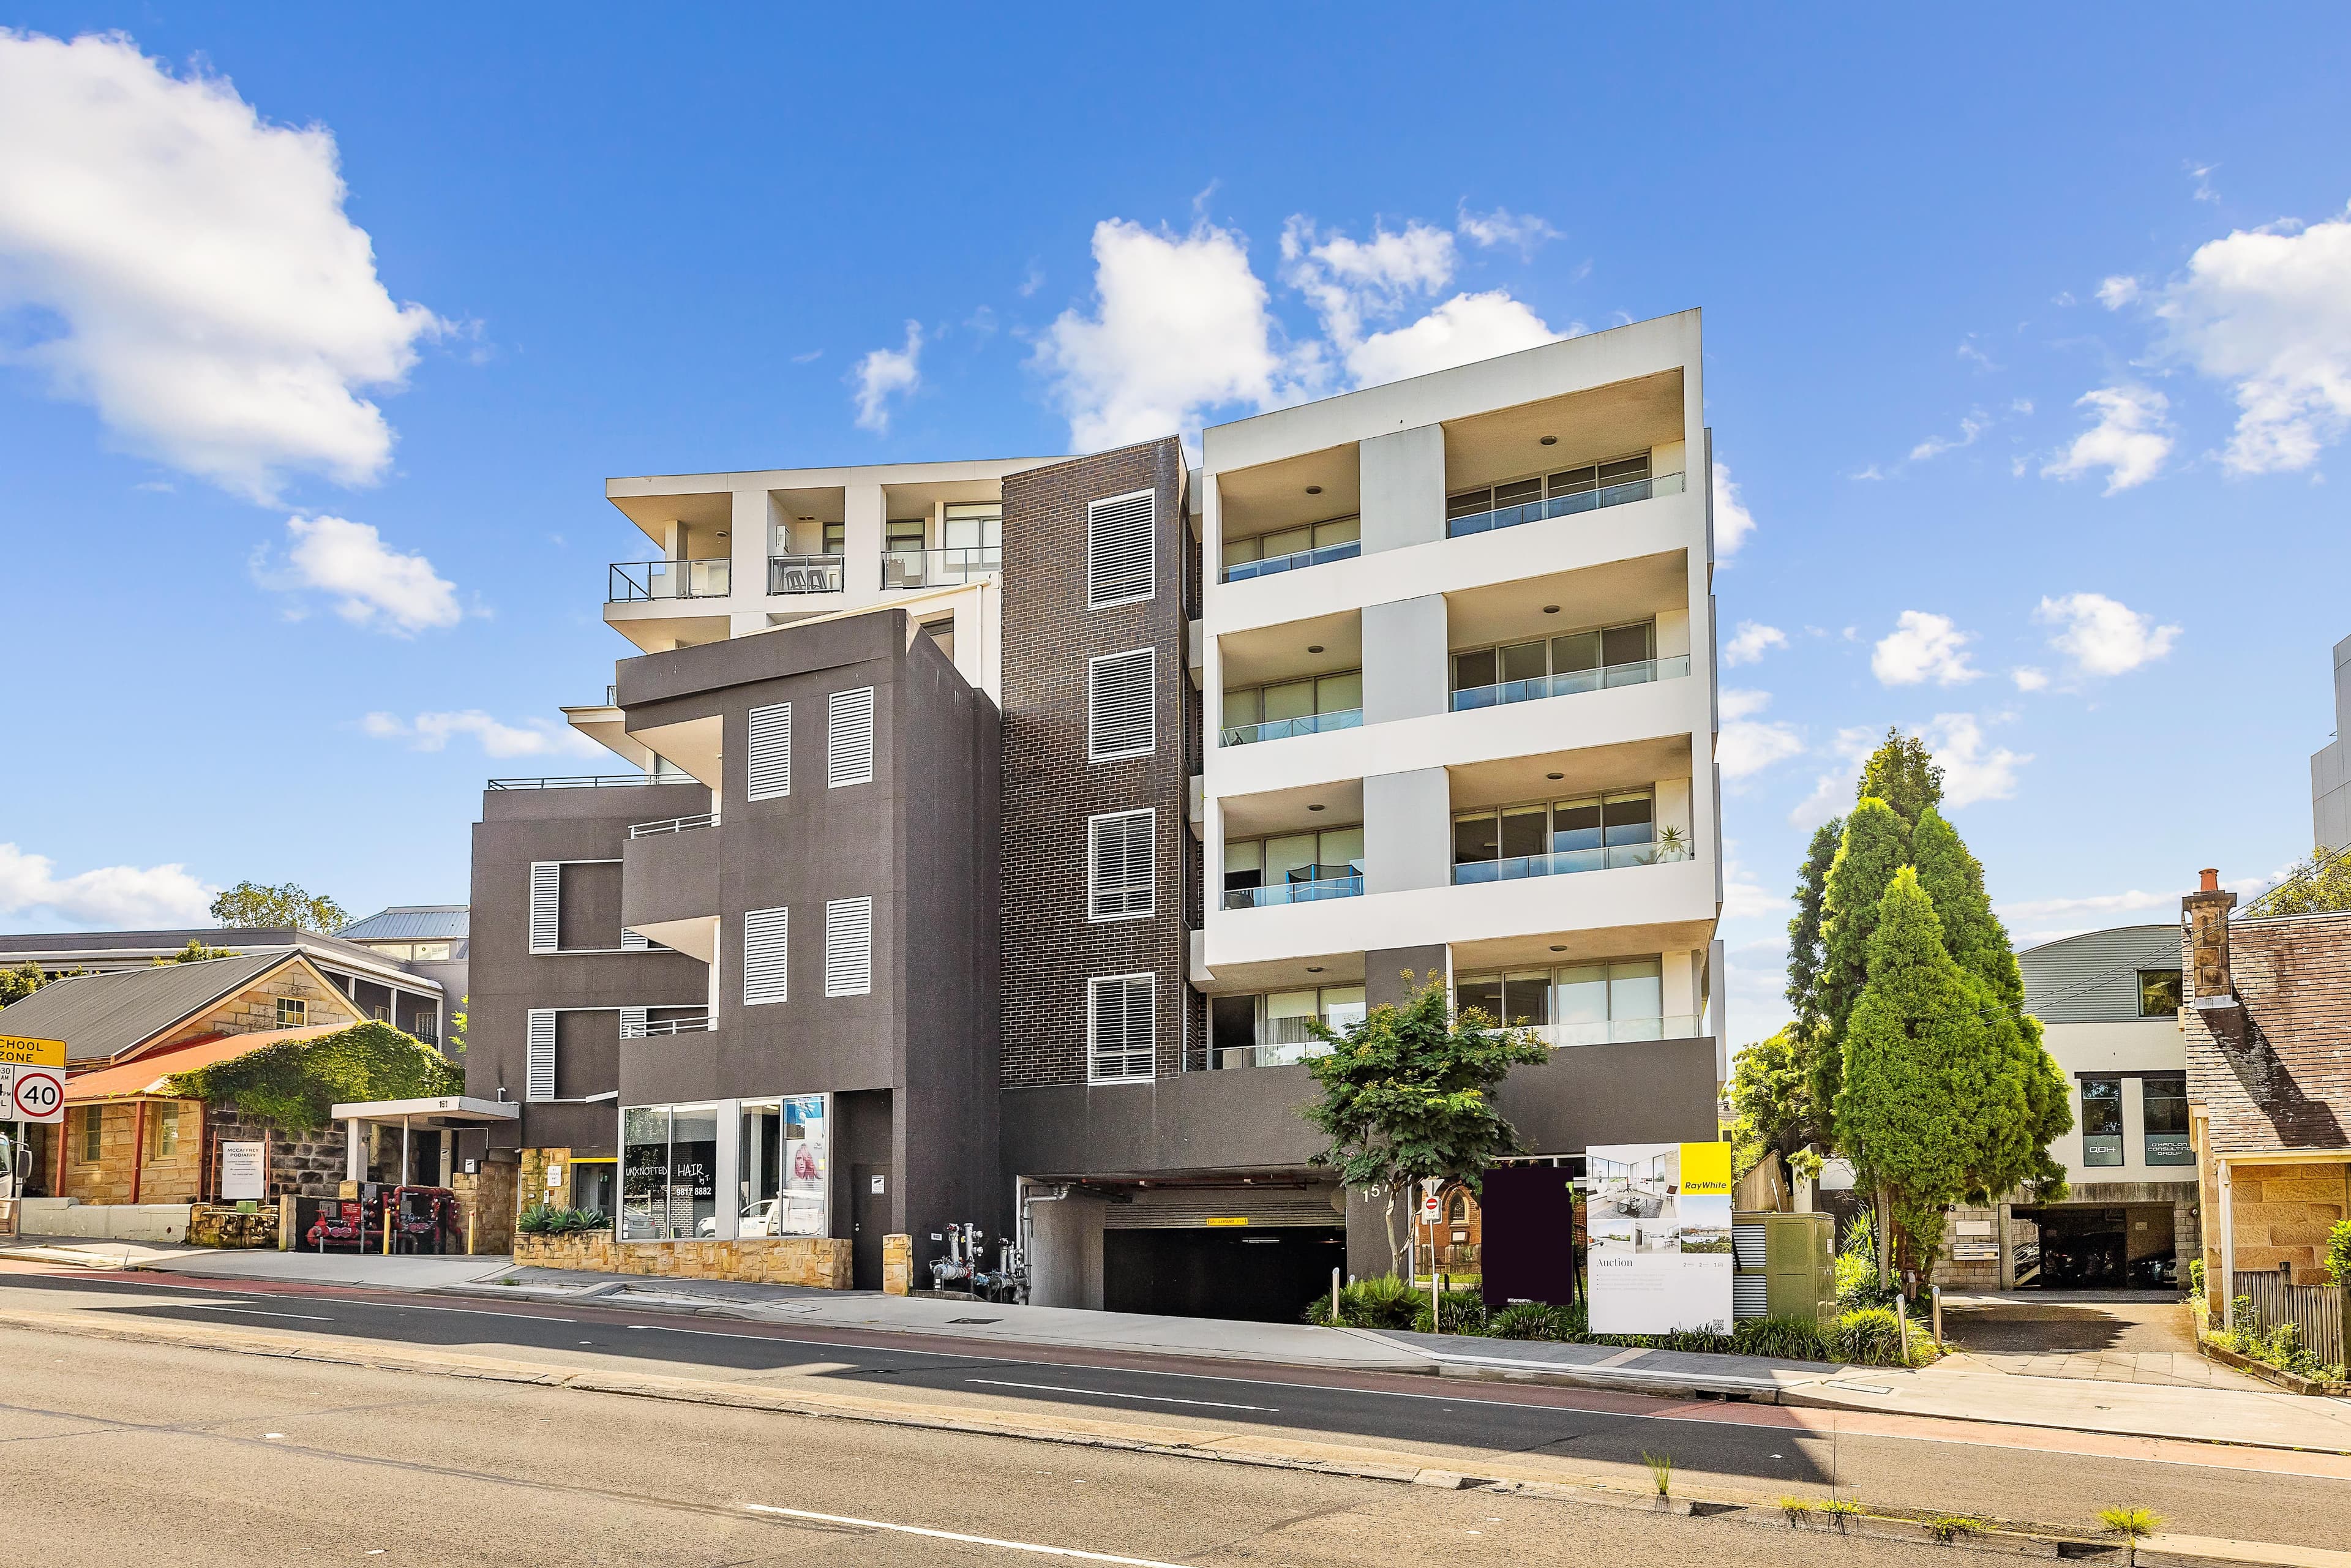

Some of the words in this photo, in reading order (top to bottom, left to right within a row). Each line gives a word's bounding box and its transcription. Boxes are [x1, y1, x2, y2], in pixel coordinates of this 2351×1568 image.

[0, 1039, 44, 1052] CHOOL
[0, 1051, 34, 1063] ZONE
[23, 1086, 56, 1105] 40
[678, 1163, 704, 1177] HAIR
[677, 1187, 693, 1196] 9817
[694, 1187, 711, 1196] 8882
[1597, 1258, 1632, 1267] Auction
